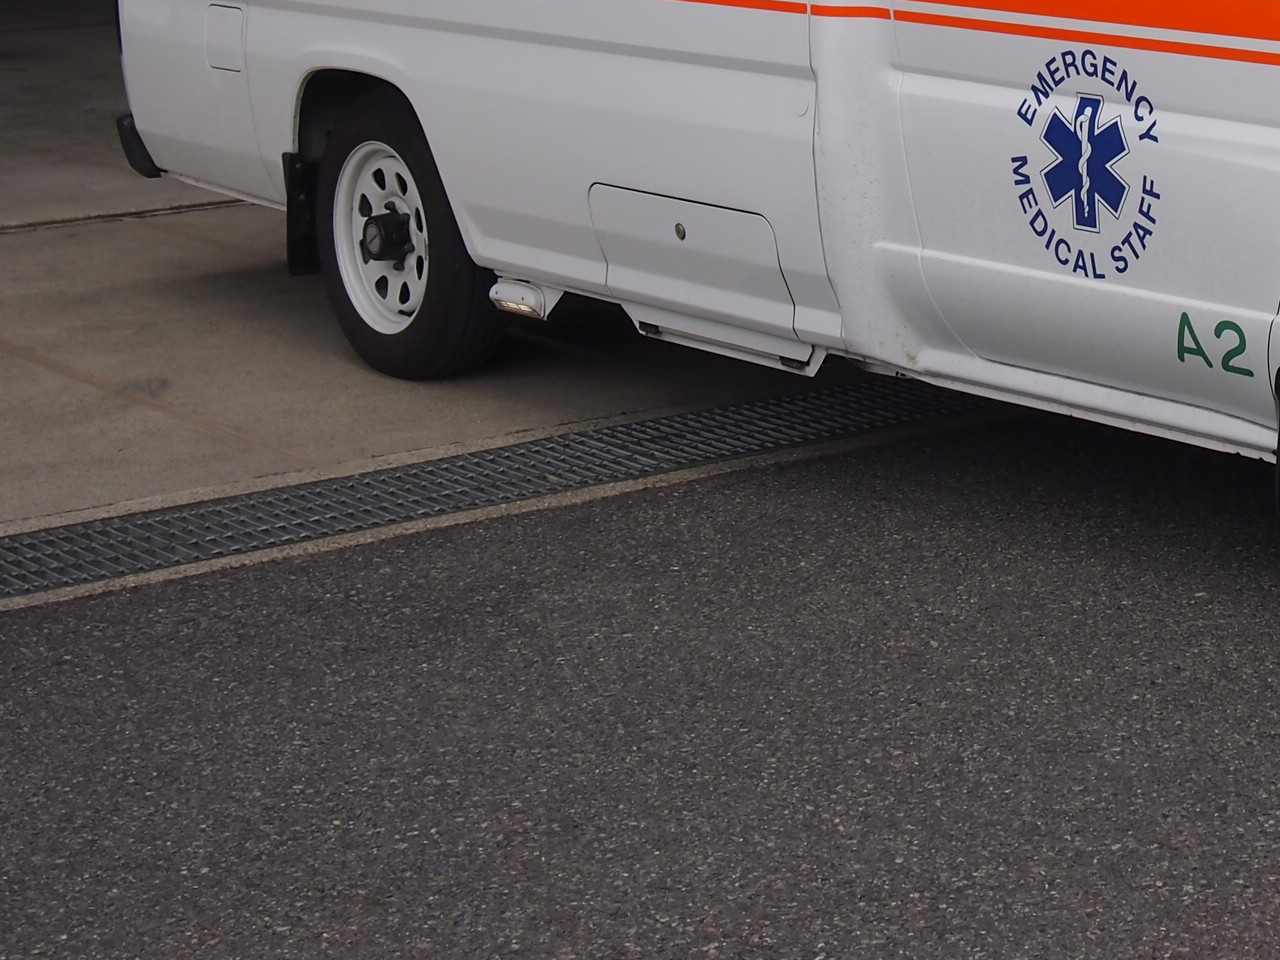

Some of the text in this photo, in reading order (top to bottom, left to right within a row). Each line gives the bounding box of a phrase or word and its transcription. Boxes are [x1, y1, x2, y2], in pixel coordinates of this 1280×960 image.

[1017, 49, 1159, 144] EMERGENCY
[1011, 155, 1161, 279] MEDICAL STAFF
[1177, 311, 1254, 378] A2
